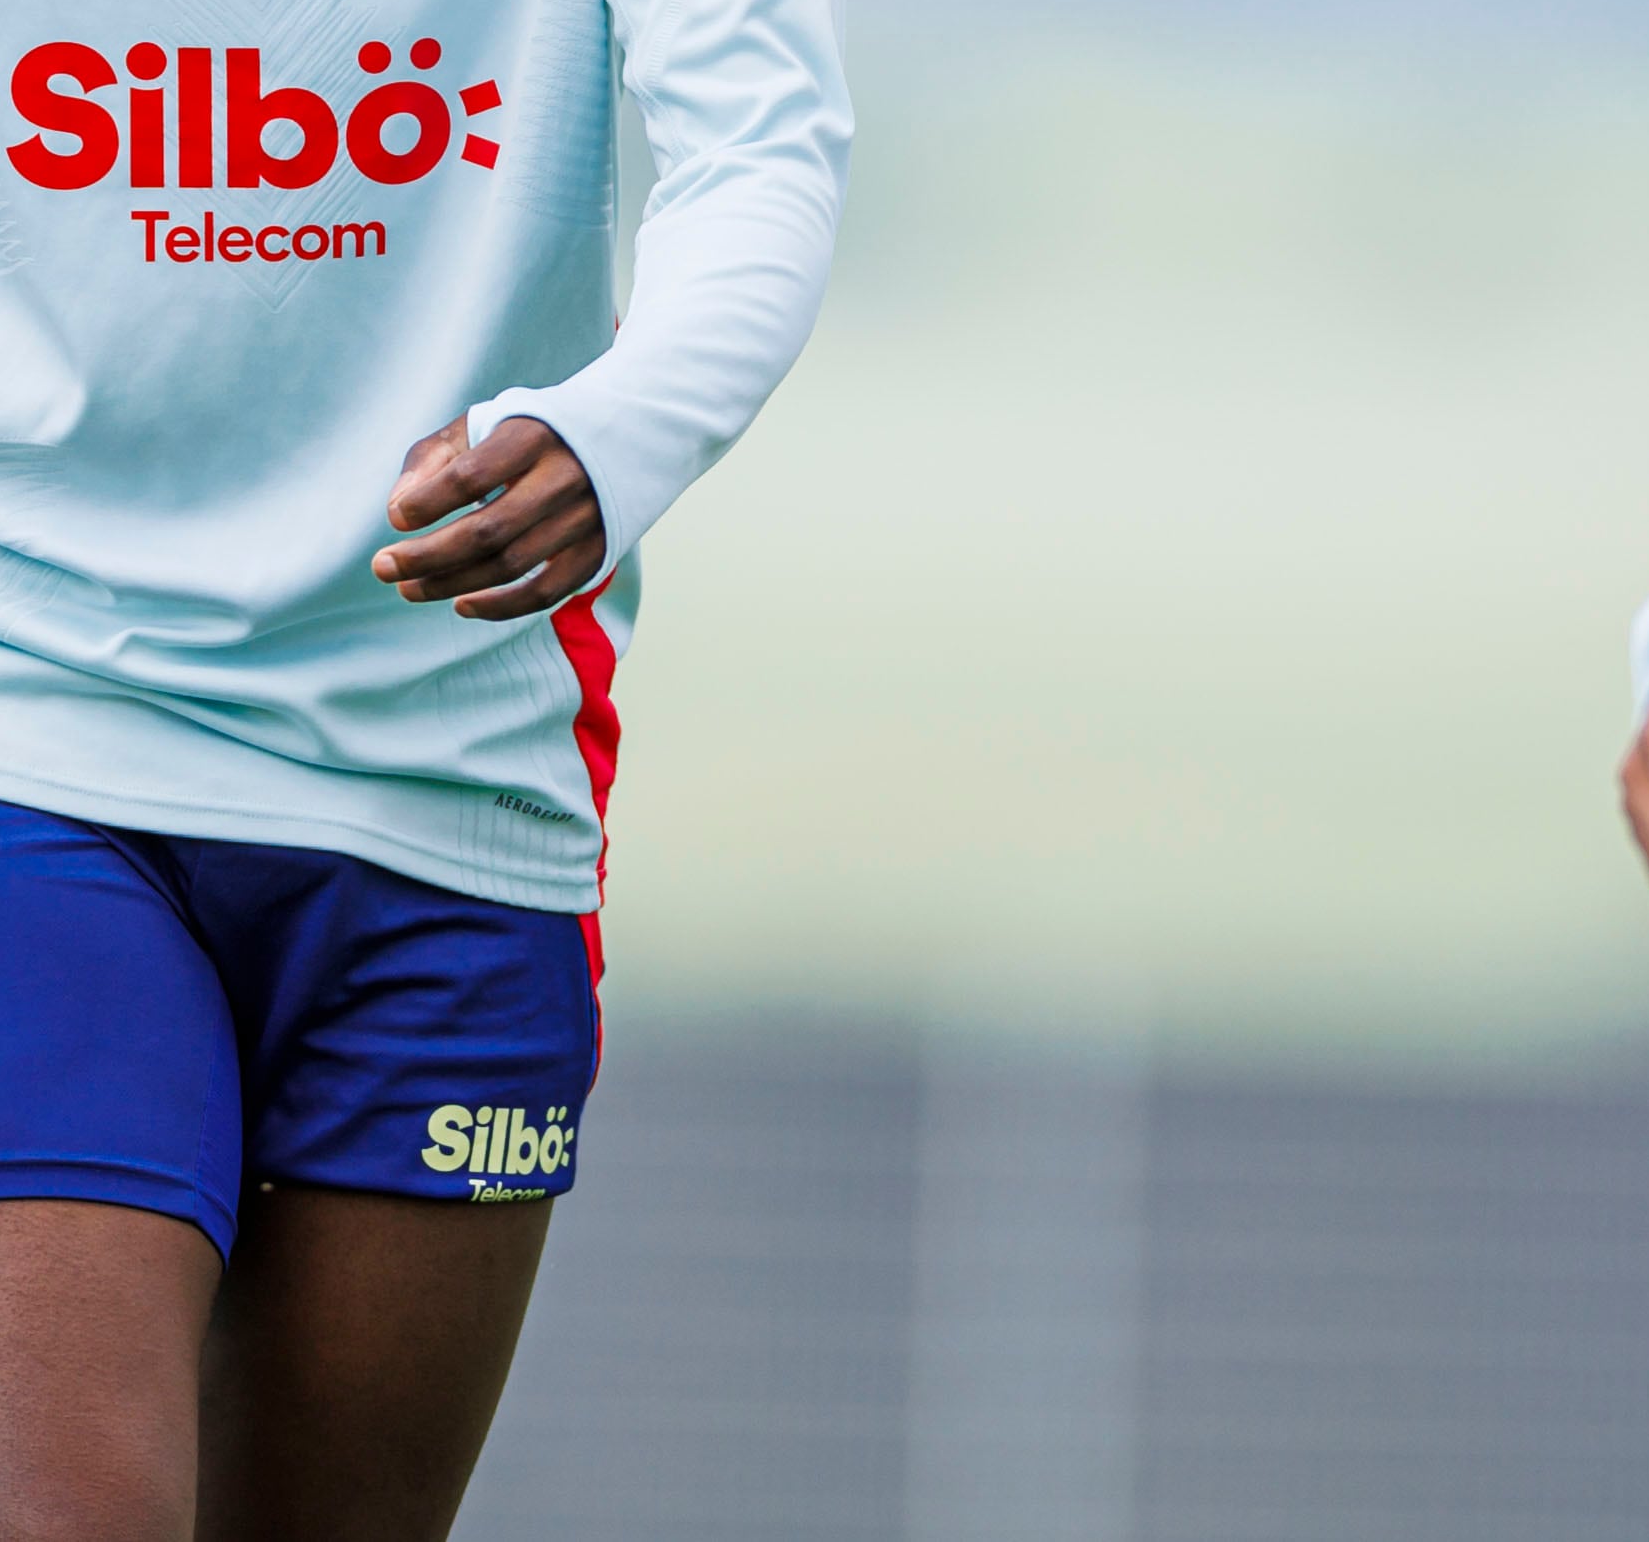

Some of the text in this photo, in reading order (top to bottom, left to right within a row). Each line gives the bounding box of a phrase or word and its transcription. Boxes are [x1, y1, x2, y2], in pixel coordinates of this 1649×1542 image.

[5, 37, 452, 190] Silbö
[131, 211, 387, 264] Telecom
[421, 1104, 567, 1175] Silbö
